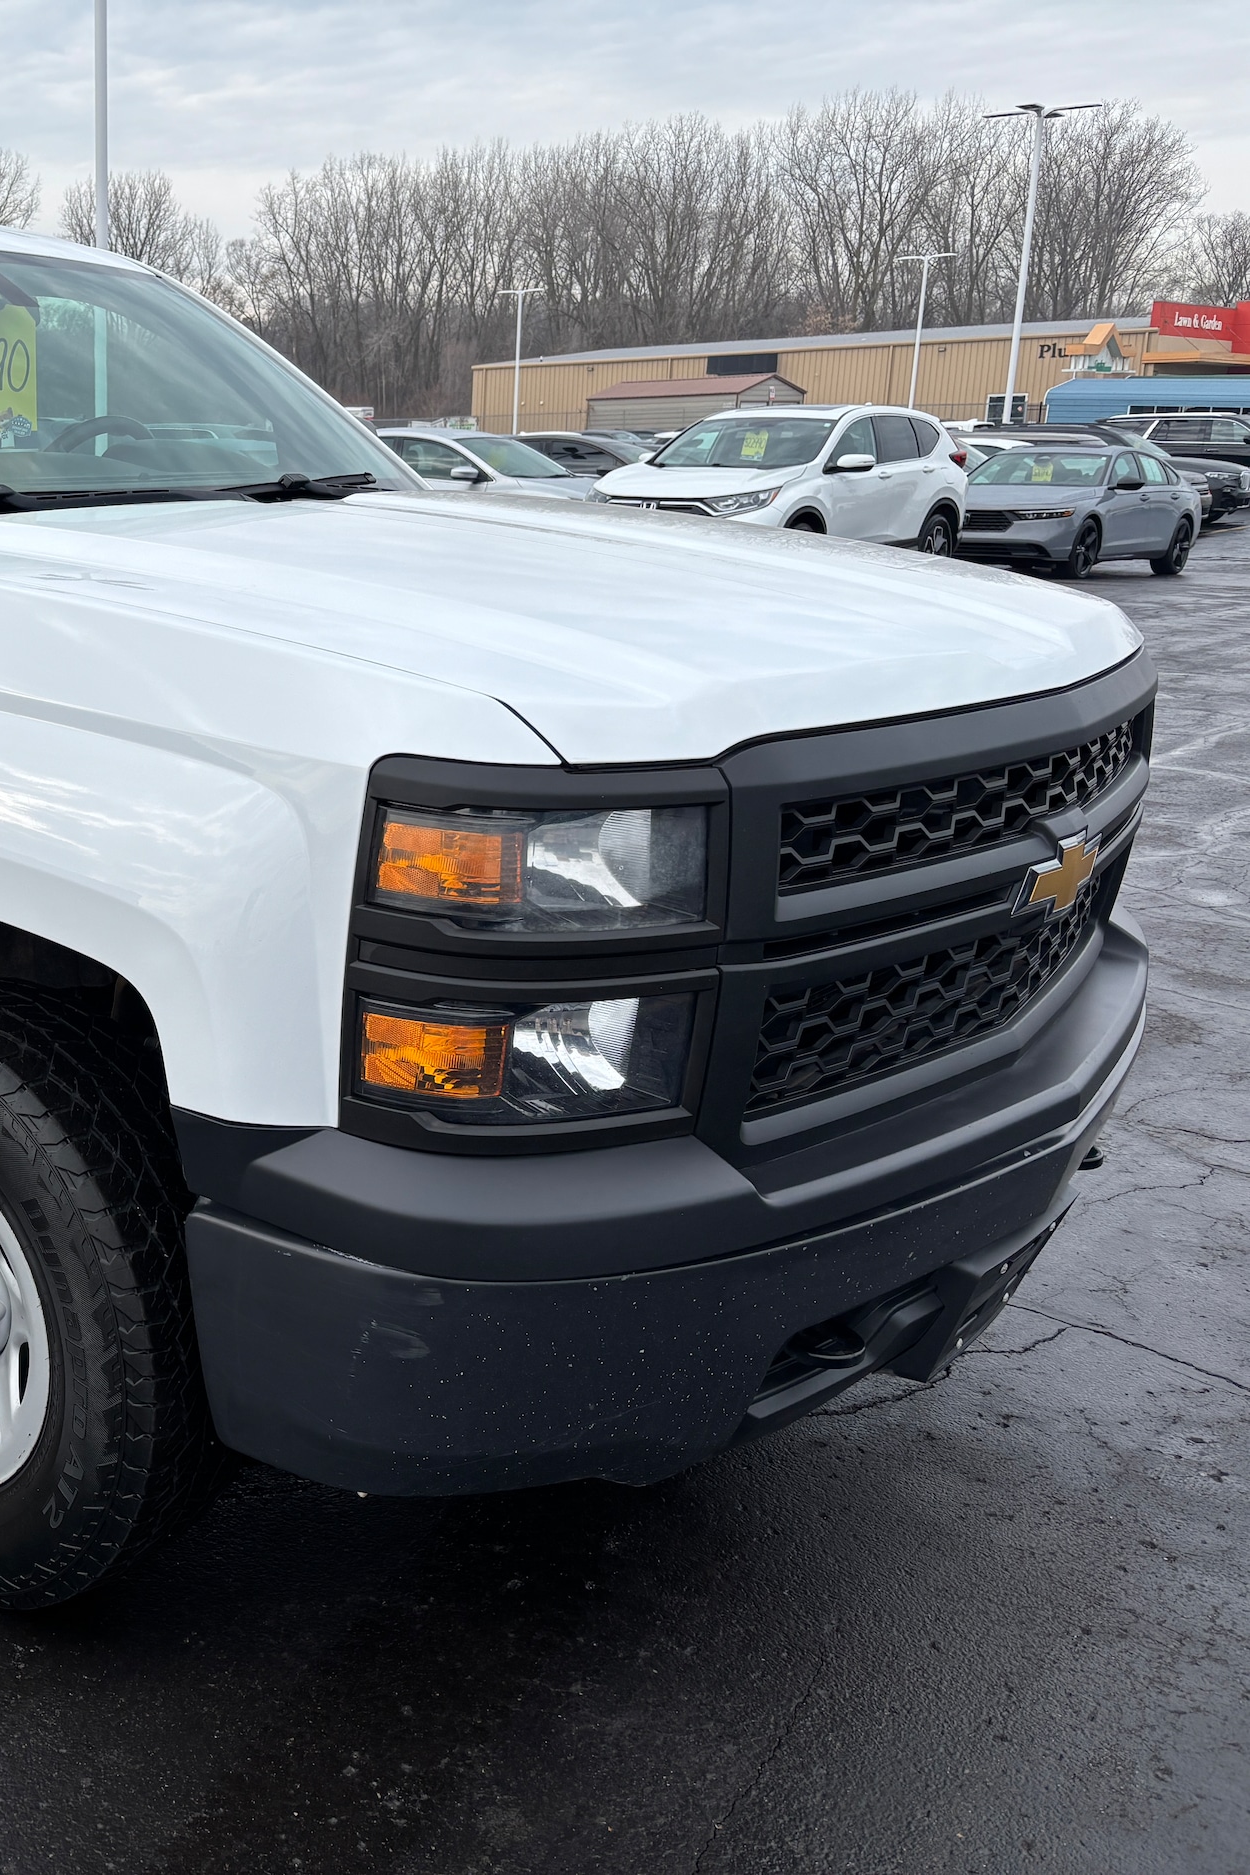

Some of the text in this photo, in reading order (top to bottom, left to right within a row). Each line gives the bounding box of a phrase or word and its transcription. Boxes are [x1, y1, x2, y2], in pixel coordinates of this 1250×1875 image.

[1174, 311, 1223, 331] Lawn & Garden
[1038, 342, 1069, 359] Plu
[42, 1442, 86, 1529] AT2
